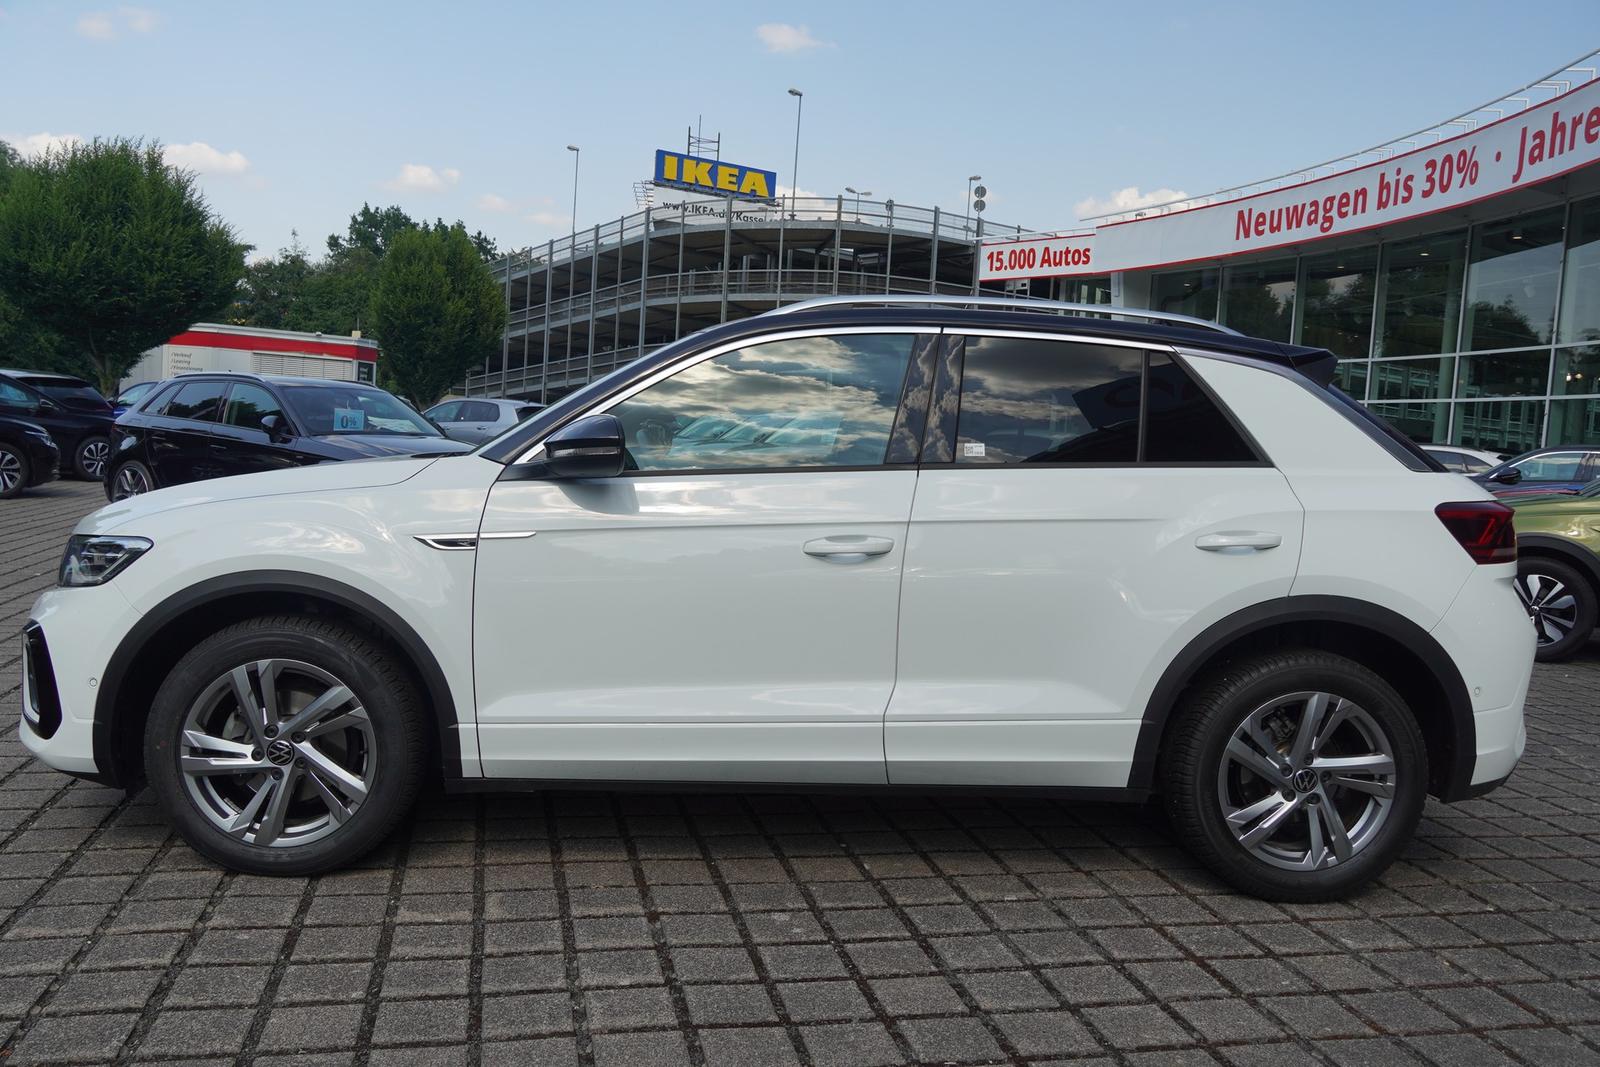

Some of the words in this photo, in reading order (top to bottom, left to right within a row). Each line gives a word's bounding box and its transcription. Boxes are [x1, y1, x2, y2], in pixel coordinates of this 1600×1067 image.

[663, 154, 770, 198] IKEA
[1235, 185, 1368, 240] Neuwagen
[1376, 168, 1414, 211] bis
[1421, 145, 1479, 199] 30%
[1512, 106, 1600, 183] Jahre
[987, 248, 1036, 271] 15.000
[1039, 246, 1091, 268] Autos
